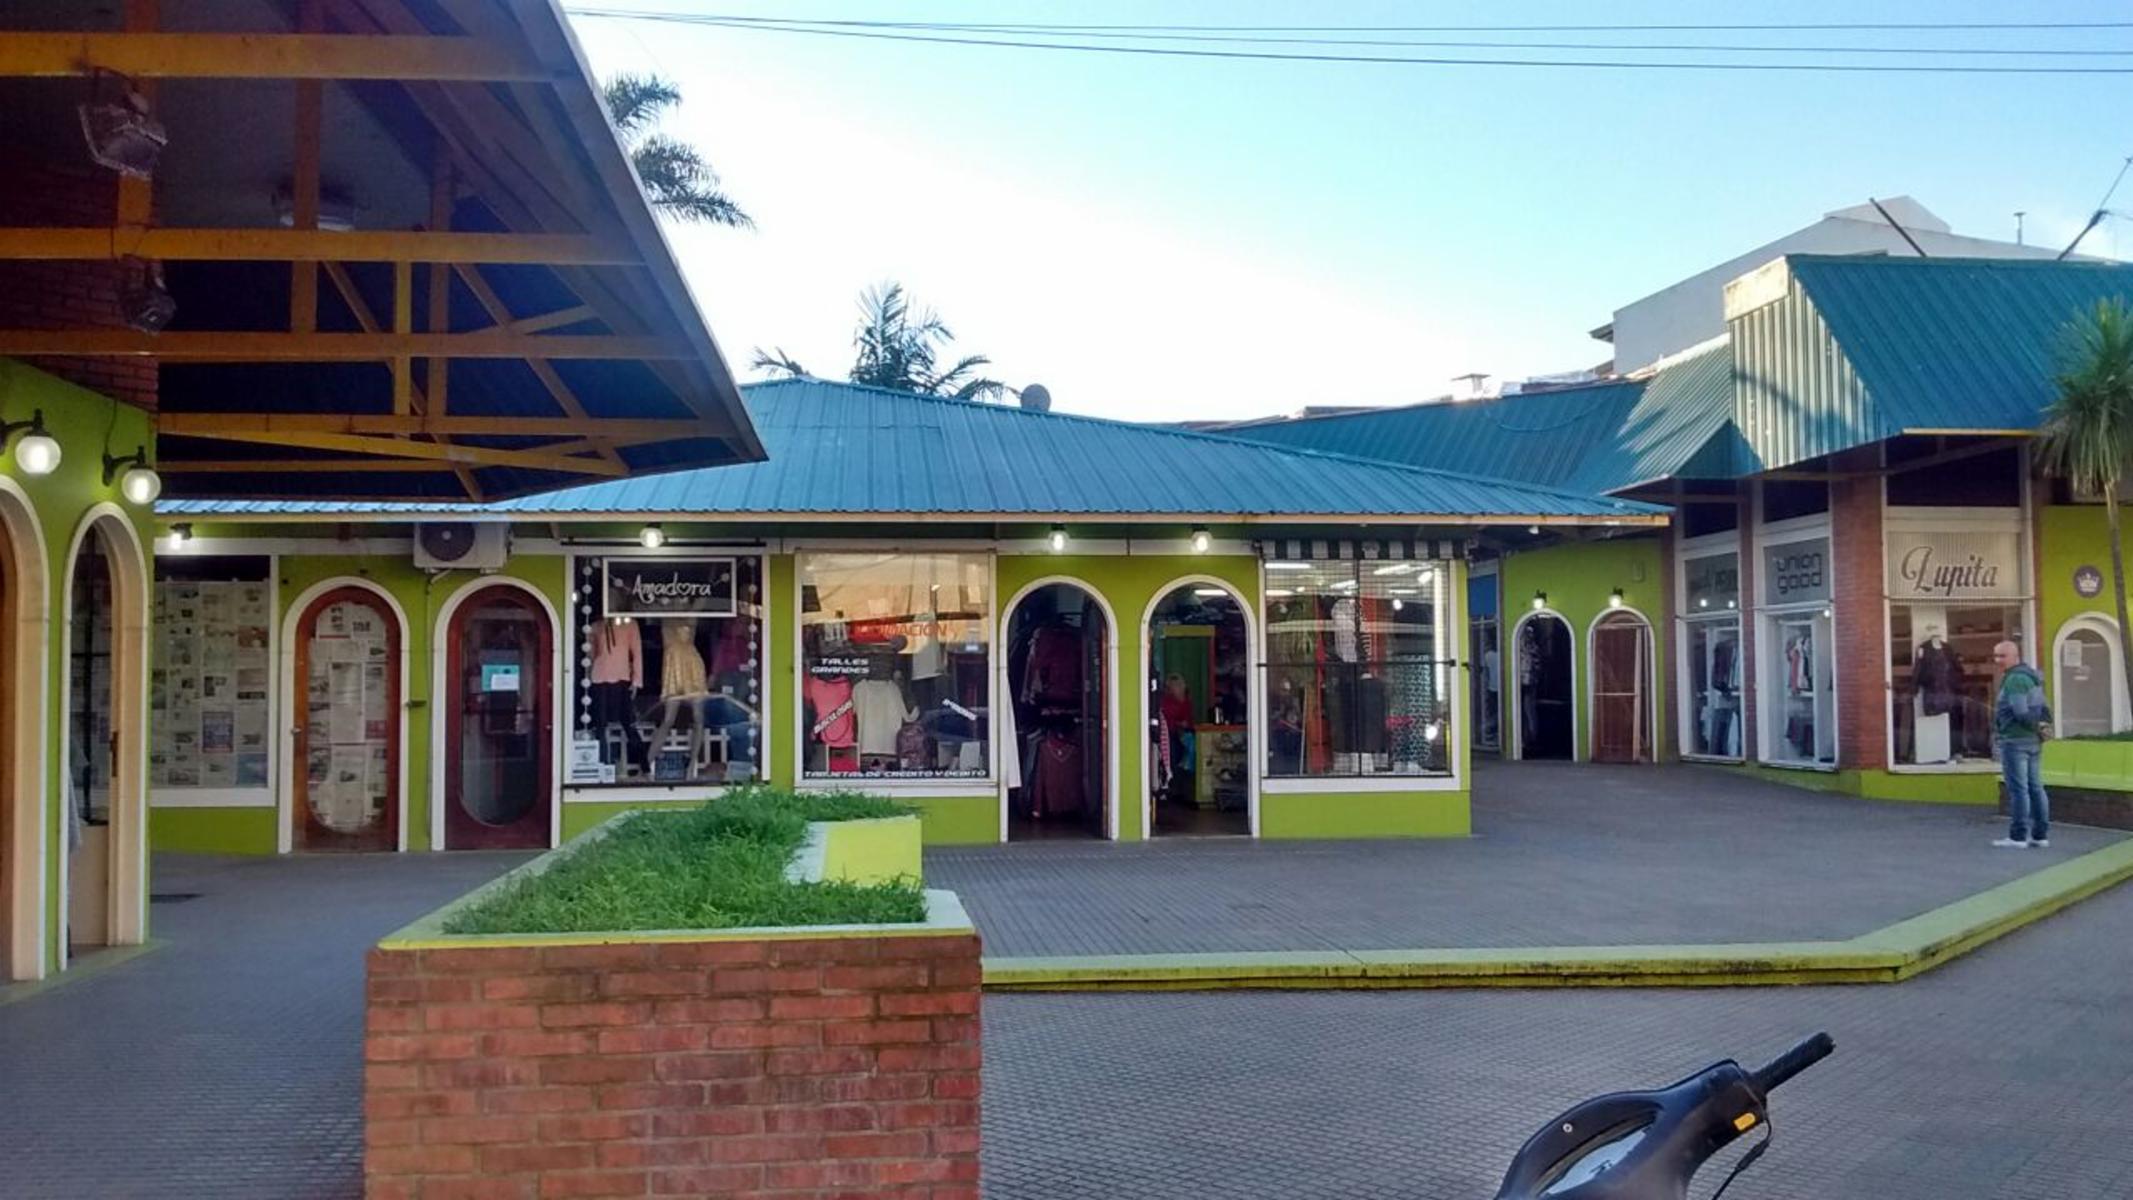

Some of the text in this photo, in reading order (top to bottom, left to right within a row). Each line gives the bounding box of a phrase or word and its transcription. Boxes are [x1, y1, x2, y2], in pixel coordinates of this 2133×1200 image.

[1775, 552, 1822, 572] union
[1900, 545, 1998, 596] Lupita
[632, 571, 712, 603] Amadora
[1776, 571, 1822, 595] good
[811, 666, 870, 674] GRANDES
